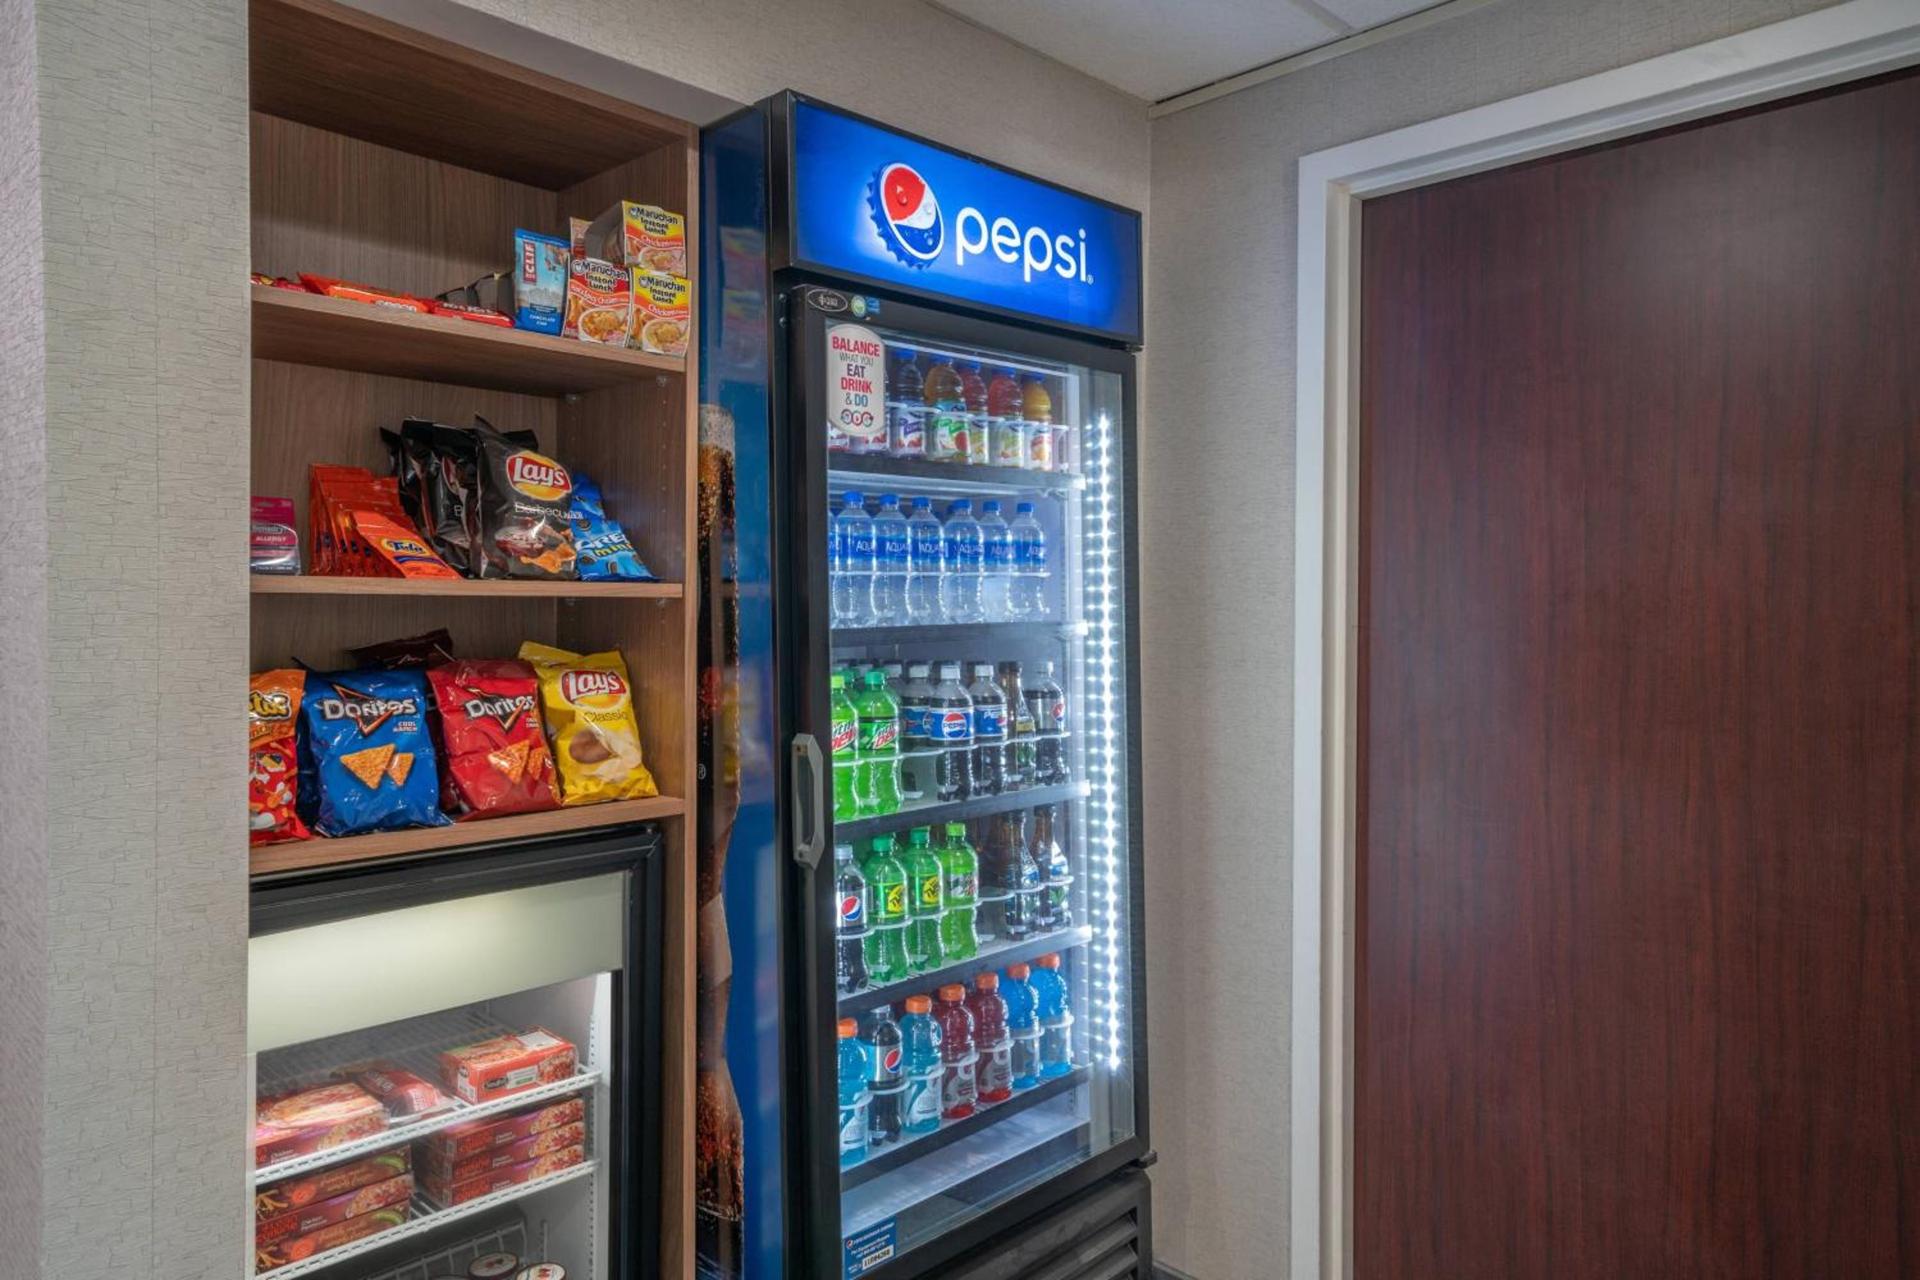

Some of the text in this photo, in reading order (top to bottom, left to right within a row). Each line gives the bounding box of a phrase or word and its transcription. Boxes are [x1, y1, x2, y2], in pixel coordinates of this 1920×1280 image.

[637, 206, 678, 224] Maruchan
[644, 225, 666, 236] Lunch
[956, 206, 1087, 283] pepsi
[582, 261, 627, 280] Maruchan
[589, 281, 613, 292] Lunch
[647, 276, 686, 292] Maruchan
[653, 295, 674, 305] Lunch
[832, 336, 880, 357] BALANCE
[840, 353, 874, 366] WHAT YOU
[847, 363, 866, 378] EAT
[841, 377, 872, 394] DRINK
[854, 394, 868, 407] DO
[323, 698, 417, 720] Doritos
[465, 695, 535, 718] Doritos
